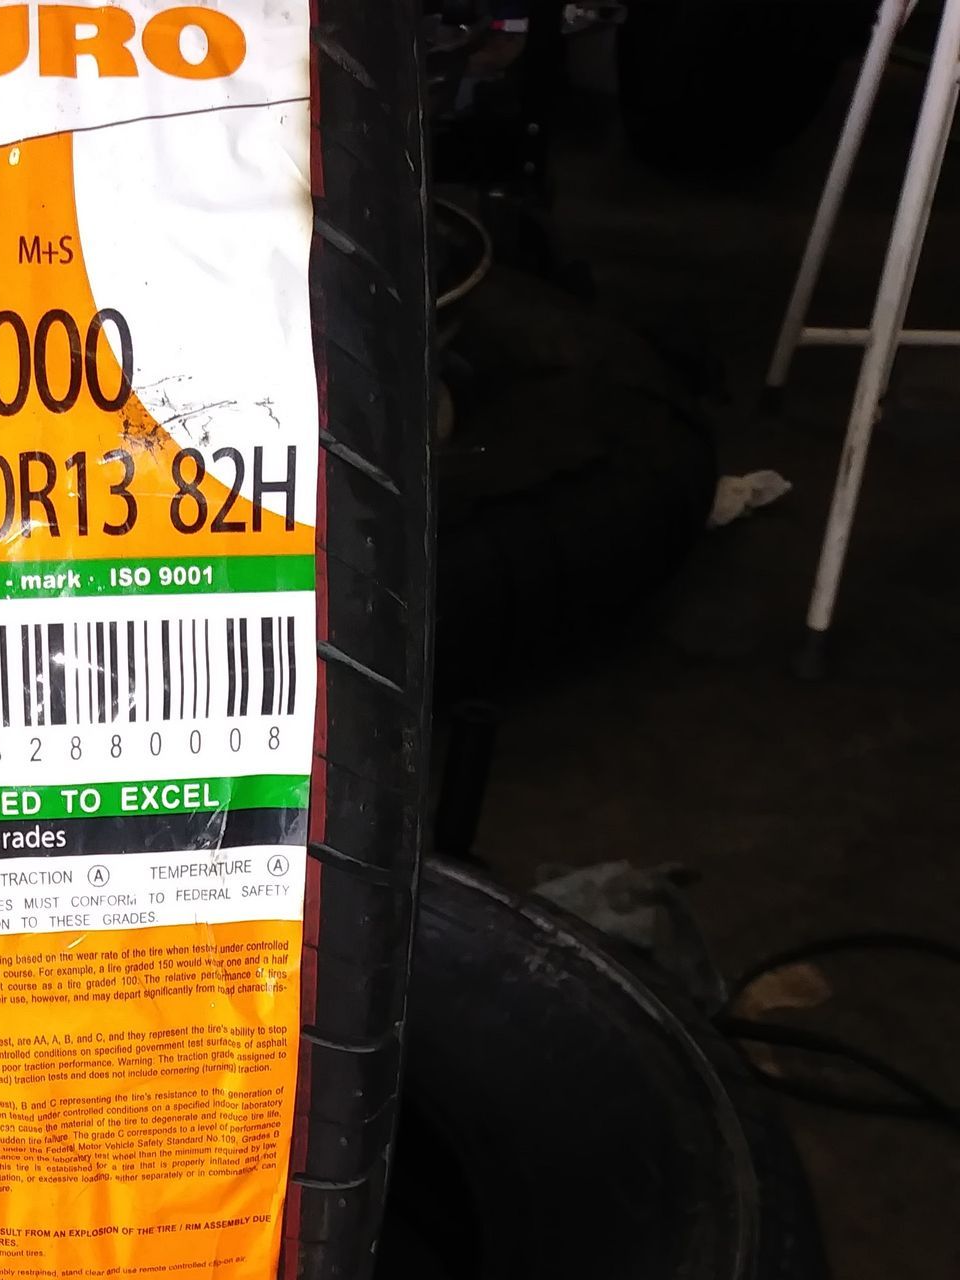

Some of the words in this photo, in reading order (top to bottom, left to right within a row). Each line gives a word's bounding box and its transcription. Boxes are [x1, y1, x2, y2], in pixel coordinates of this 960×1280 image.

[19, 235, 74, 265] M+S
[170, 446, 297, 537] 82H
[20, 572, 80, 590] mark
[110, 567, 151, 587] ISO
[158, 566, 214, 586] 9001
[61, 790, 101, 814] TO
[121, 783, 220, 811] EXCEL
[0, 871, 73, 887] TRACTION
[150, 859, 252, 881] TEMPERATURE
[24, 895, 60, 911] MUST
[71, 893, 137, 909] CONFORM
[148, 890, 166, 905] TO
[175, 887, 232, 904] FEDERAL
[241, 883, 290, 899] SAFETY
[22, 916, 38, 930] TO
[49, 913, 92, 929] THESE
[103, 910, 159, 926] GRADES.
[15, 953, 42, 964] based
[45, 954, 56, 962] on
[59, 952, 73, 962] the
[100, 949, 118, 960] rate
[132, 948, 146, 958] the
[148, 947, 162, 957] tire
[165, 945, 189, 956] when
[220, 942, 243, 952] under
[246, 941, 288, 952] controlled
[3, 970, 35, 978] course.
[38, 967, 53, 978] For
[56, 965, 95, 979] example,
[107, 964, 121, 974] tire
[124, 961, 154, 975] graded
[158, 960, 173, 971] 150
[176, 958, 202, 969] would
[226, 959, 241, 967] one
[244, 956, 260, 967] and
[271, 954, 288, 965] half
[7, 983, 37, 992] course
[42, 982, 52, 991] as
[67, 979, 81, 990] tire
[85, 977, 116, 991] graded
[145, 974, 160, 985] The
[164, 972, 196, 984] relative
[268, 969, 287, 979] tires
[17, 1038, 31, 1046] are
[76, 1034, 92, 1044] and
[108, 1032, 124, 1042] and
[127, 1030, 145, 1043] they
[148, 1027, 188, 1041] represent
[191, 1025, 204, 1037] the
[230, 1025, 254, 1038] ability
[257, 1025, 265, 1035] to
[268, 1024, 287, 1037] stop
[24, 1228, 50, 1237] FROM
[53, 1228, 65, 1238] AN
[68, 1225, 118, 1238] EXPLOSION
[121, 1226, 133, 1235] OF
[137, 1226, 153, 1235] THE
[157, 1224, 176, 1234] TIRE
[185, 1222, 201, 1232] RIM
[203, 1217, 249, 1230] ASSEMBLY
[252, 1214, 270, 1225] DUE
